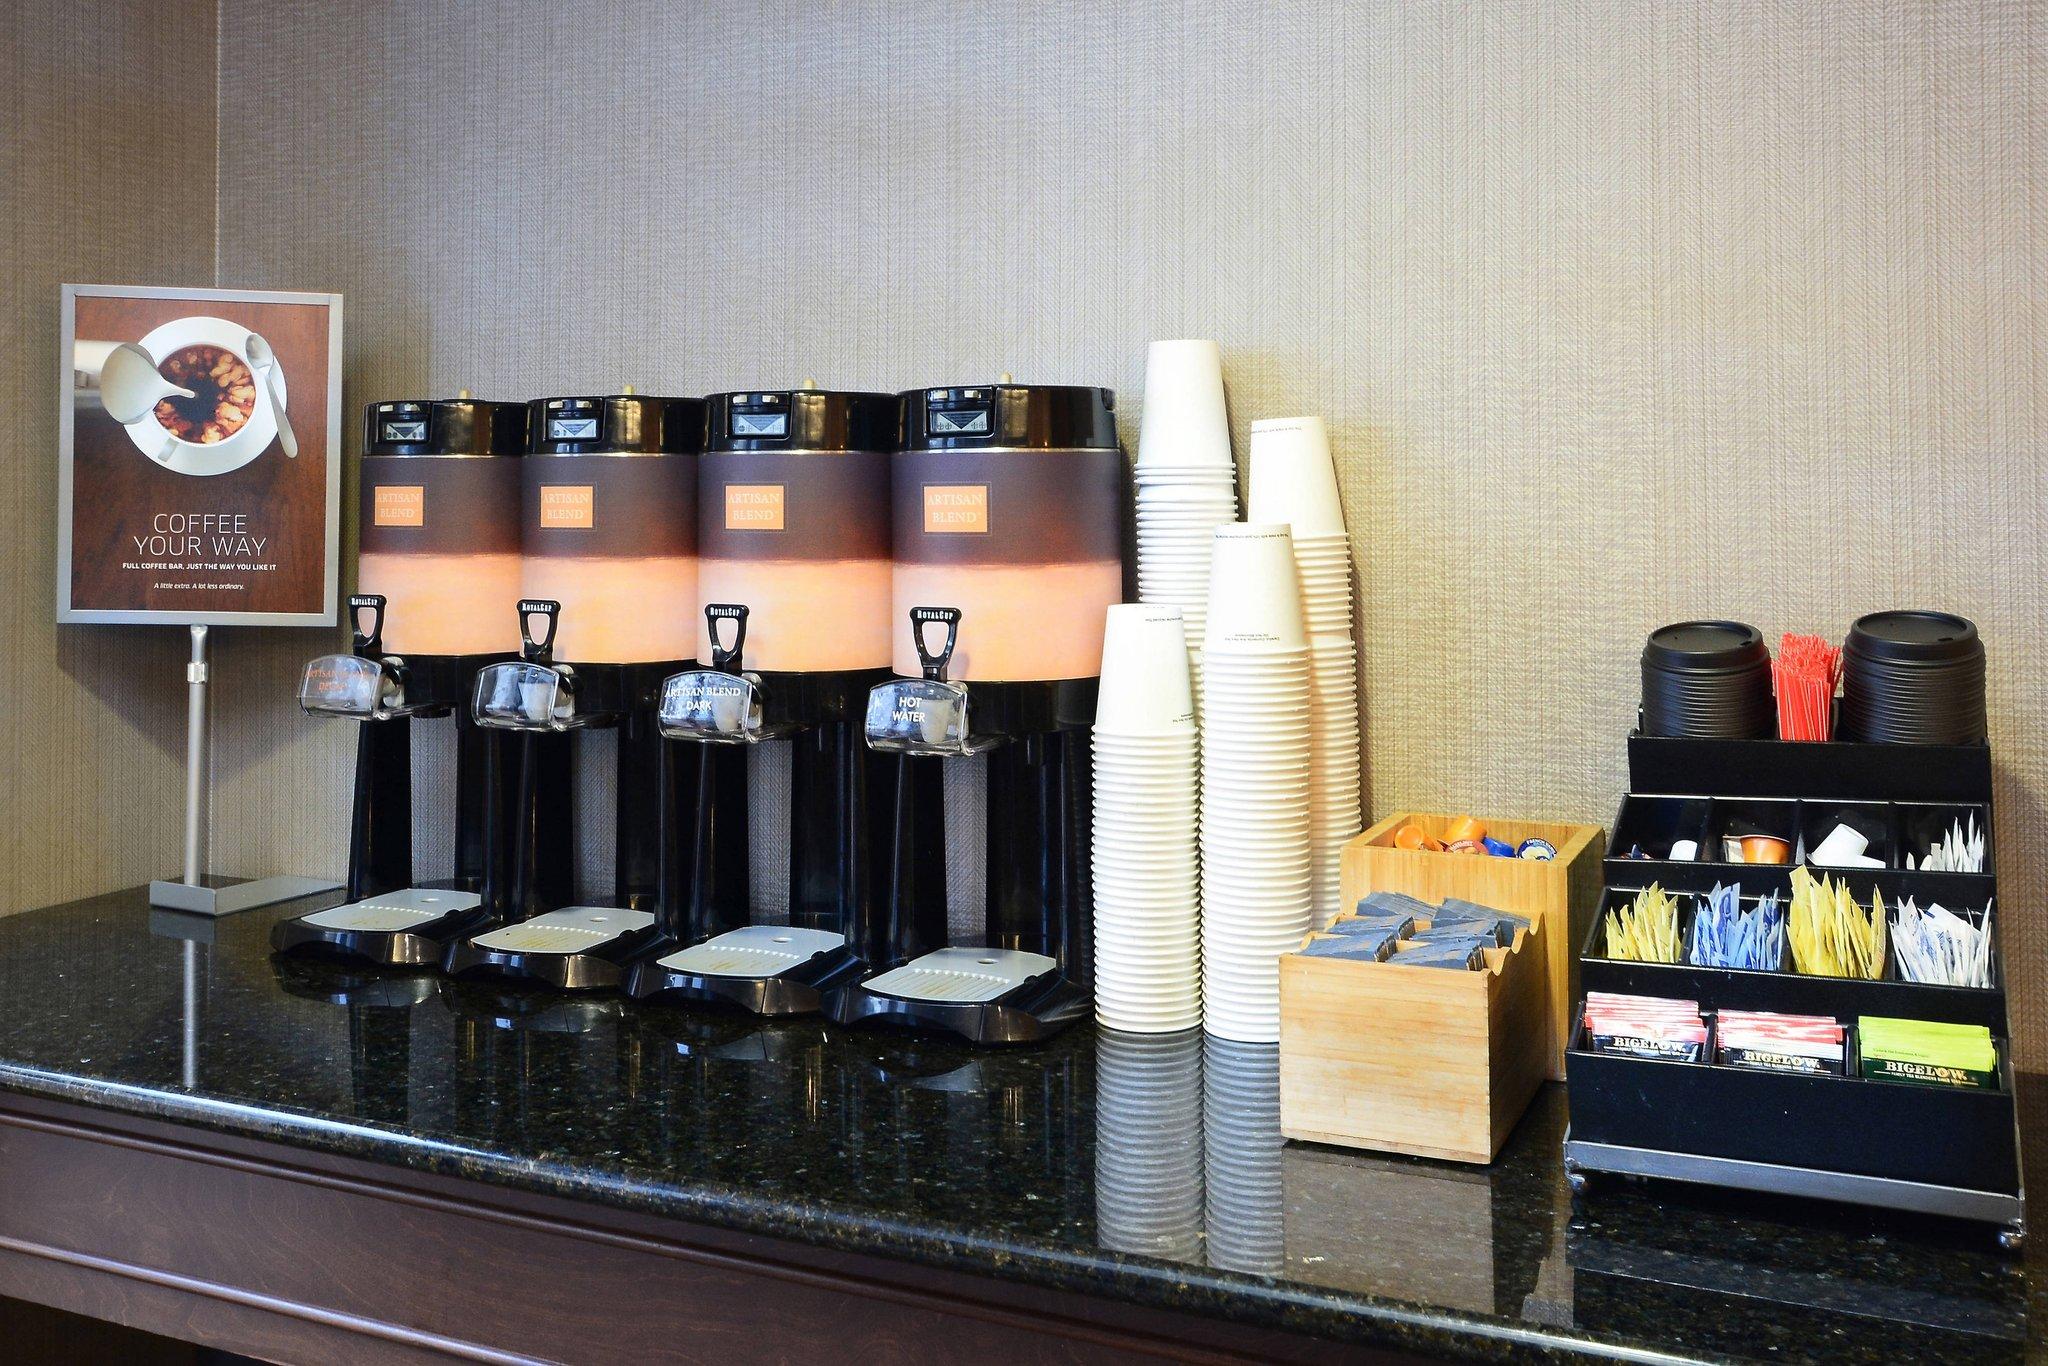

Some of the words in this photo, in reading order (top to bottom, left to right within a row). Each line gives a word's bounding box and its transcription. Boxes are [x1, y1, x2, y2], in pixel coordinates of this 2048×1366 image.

[543, 493, 588, 504] ARTISAN
[728, 493, 780, 504] ARTISAN
[927, 494, 984, 505] ARTISAN
[547, 509, 584, 520] BLEND
[733, 510, 774, 520] BLEND
[932, 511, 977, 522] BLEND
[153, 513, 247, 534] COFFEE
[133, 535, 202, 556] YOUR
[212, 536, 267, 557] WAY
[122, 562, 140, 570] FULL
[141, 562, 167, 570] COFFEE
[219, 563, 235, 571] WAY
[236, 563, 251, 571] YOU
[664, 687, 704, 698] ARTISAN
[707, 687, 741, 697] BLEND
[686, 700, 712, 711] DARK
[898, 696, 922, 708] HOT
[892, 711, 926, 723] WATER
